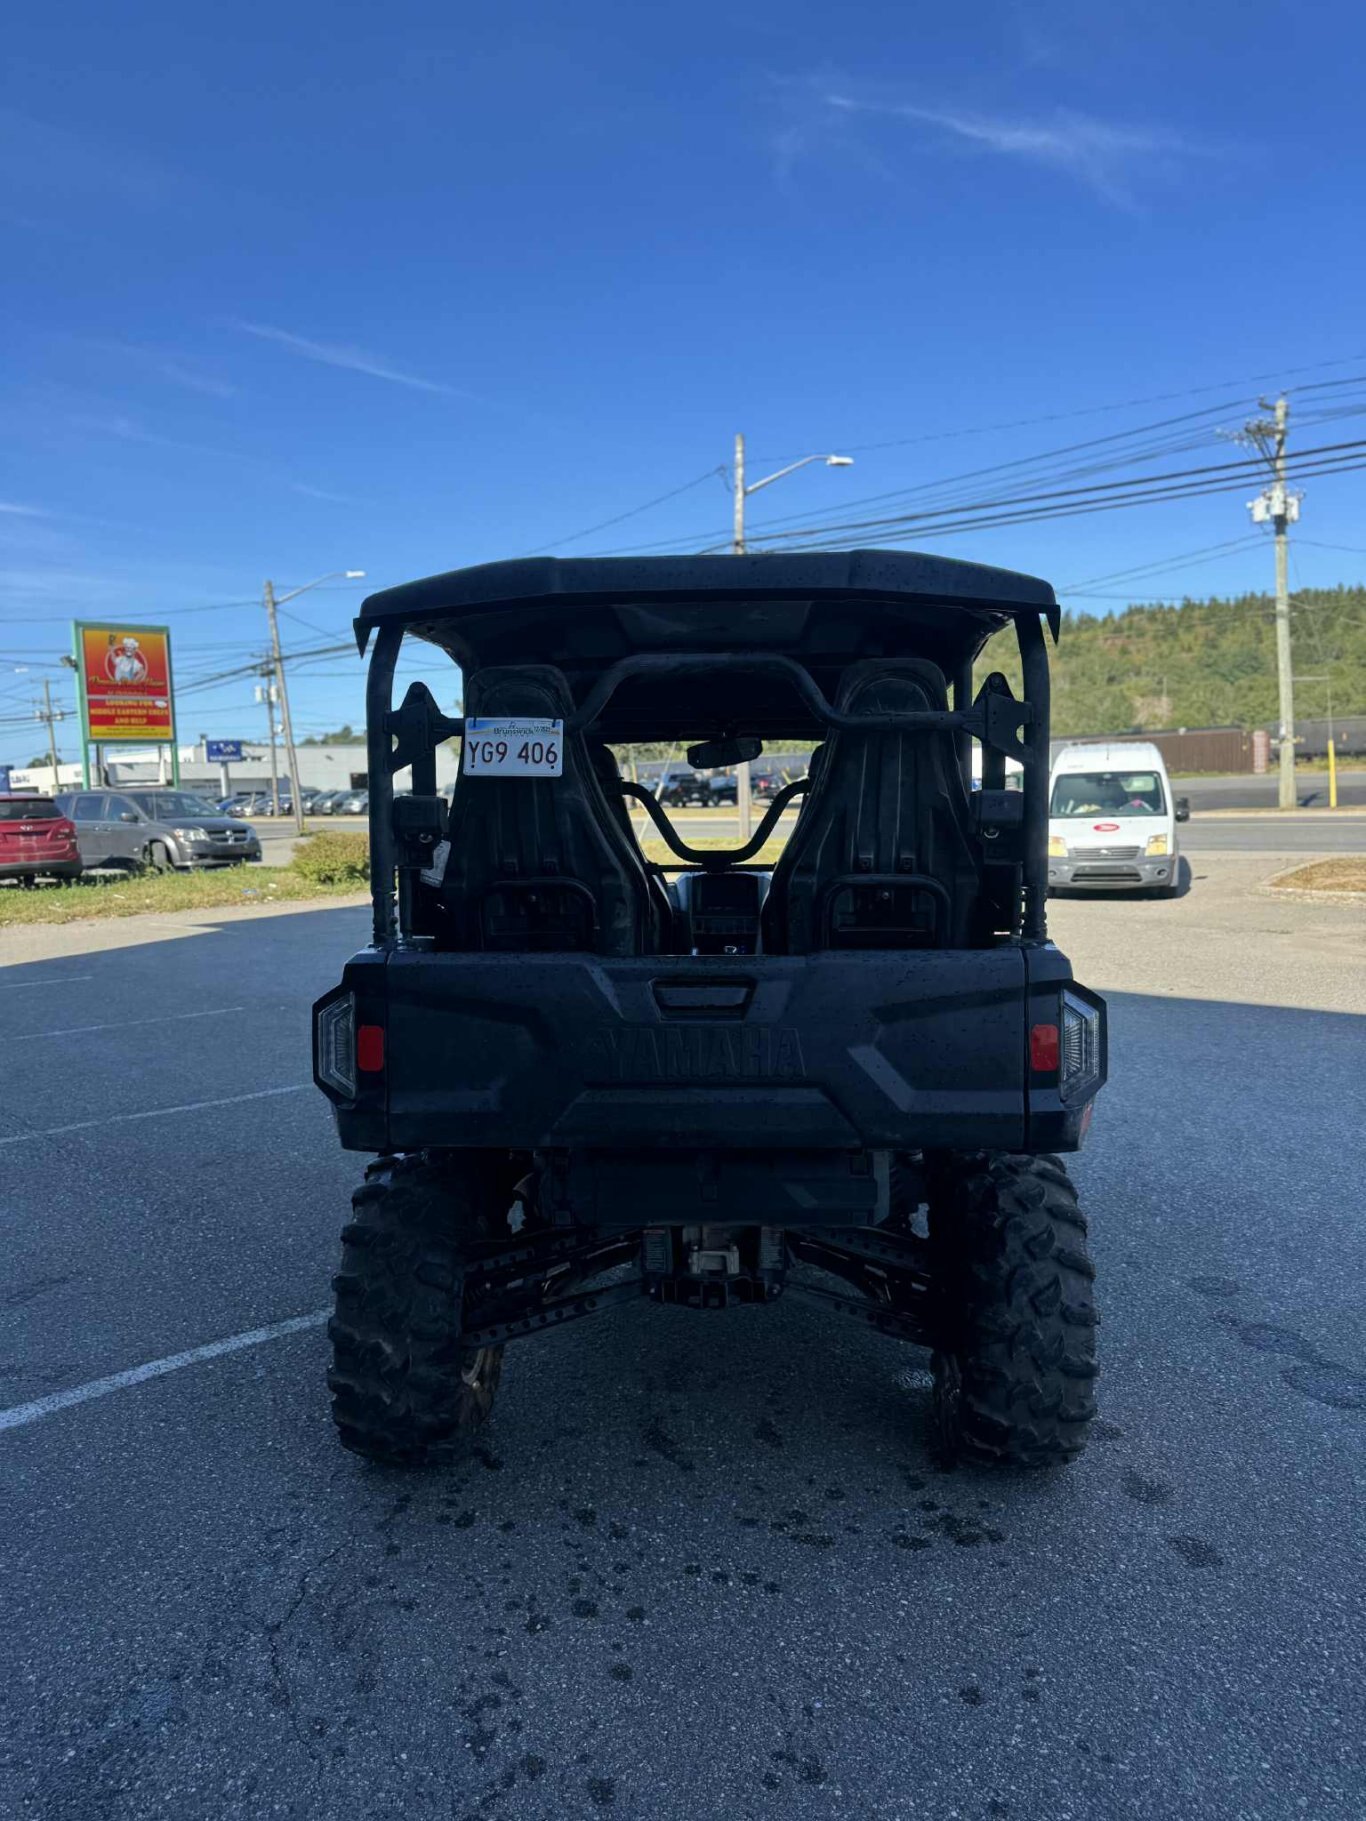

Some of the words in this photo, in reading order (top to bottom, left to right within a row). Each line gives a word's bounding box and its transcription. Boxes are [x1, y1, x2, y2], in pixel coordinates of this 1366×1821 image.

[468, 741, 508, 764] YG9
[517, 742, 558, 765] 406
[602, 1027, 807, 1078] YAMAHA
